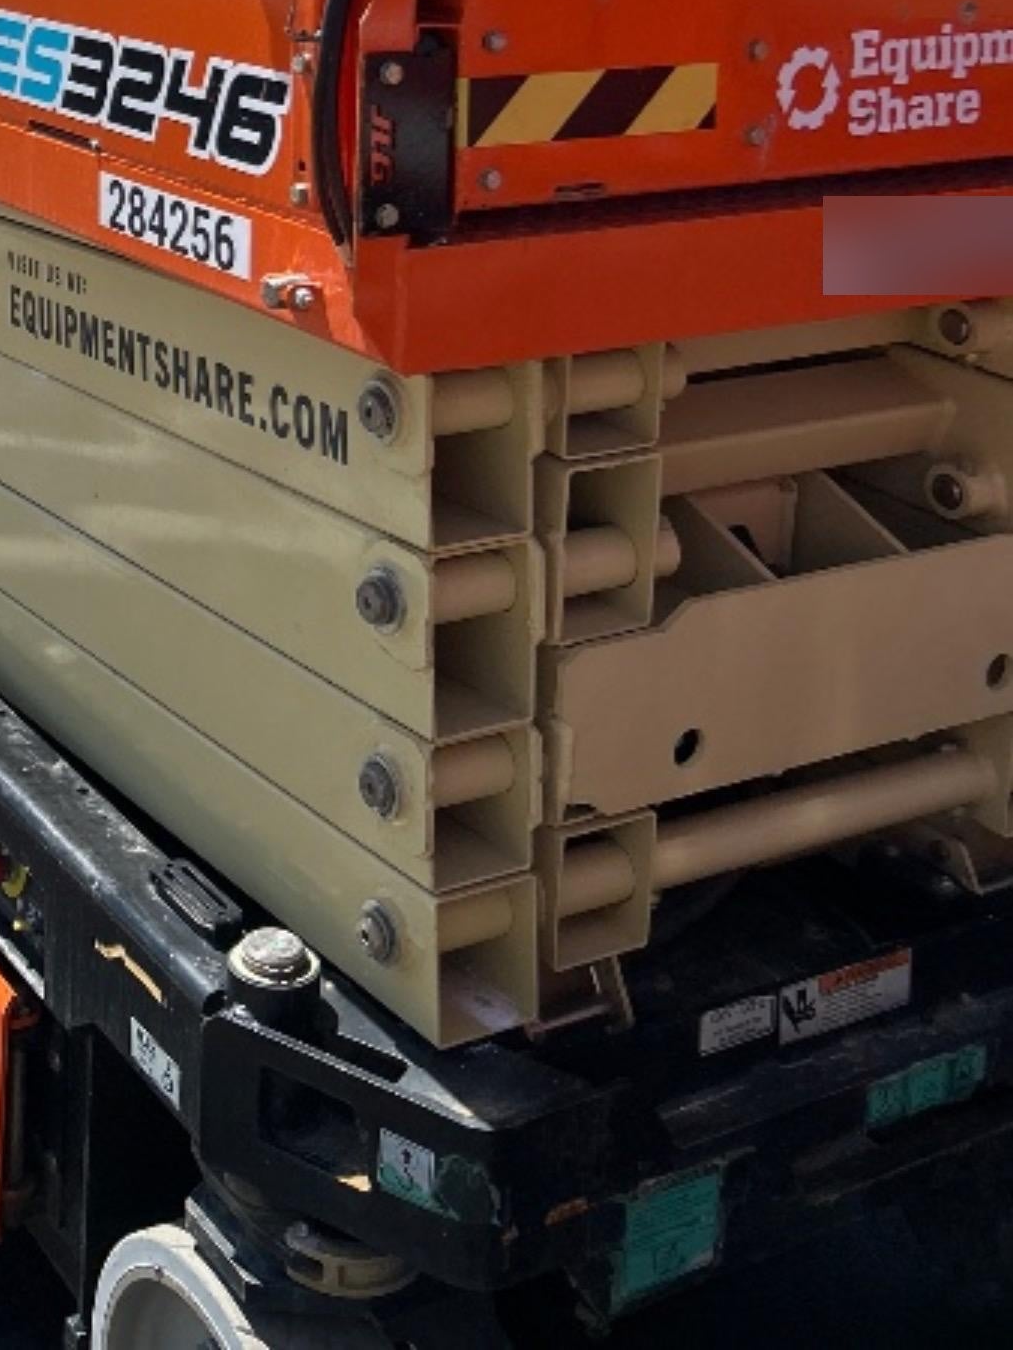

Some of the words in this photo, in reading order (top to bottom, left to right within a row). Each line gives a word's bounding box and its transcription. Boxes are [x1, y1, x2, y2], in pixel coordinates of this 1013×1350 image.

[847, 86, 981, 136] Share
[108, 179, 236, 272] 284256
[9, 284, 349, 466] EQUIPMENTSHARE.COM
